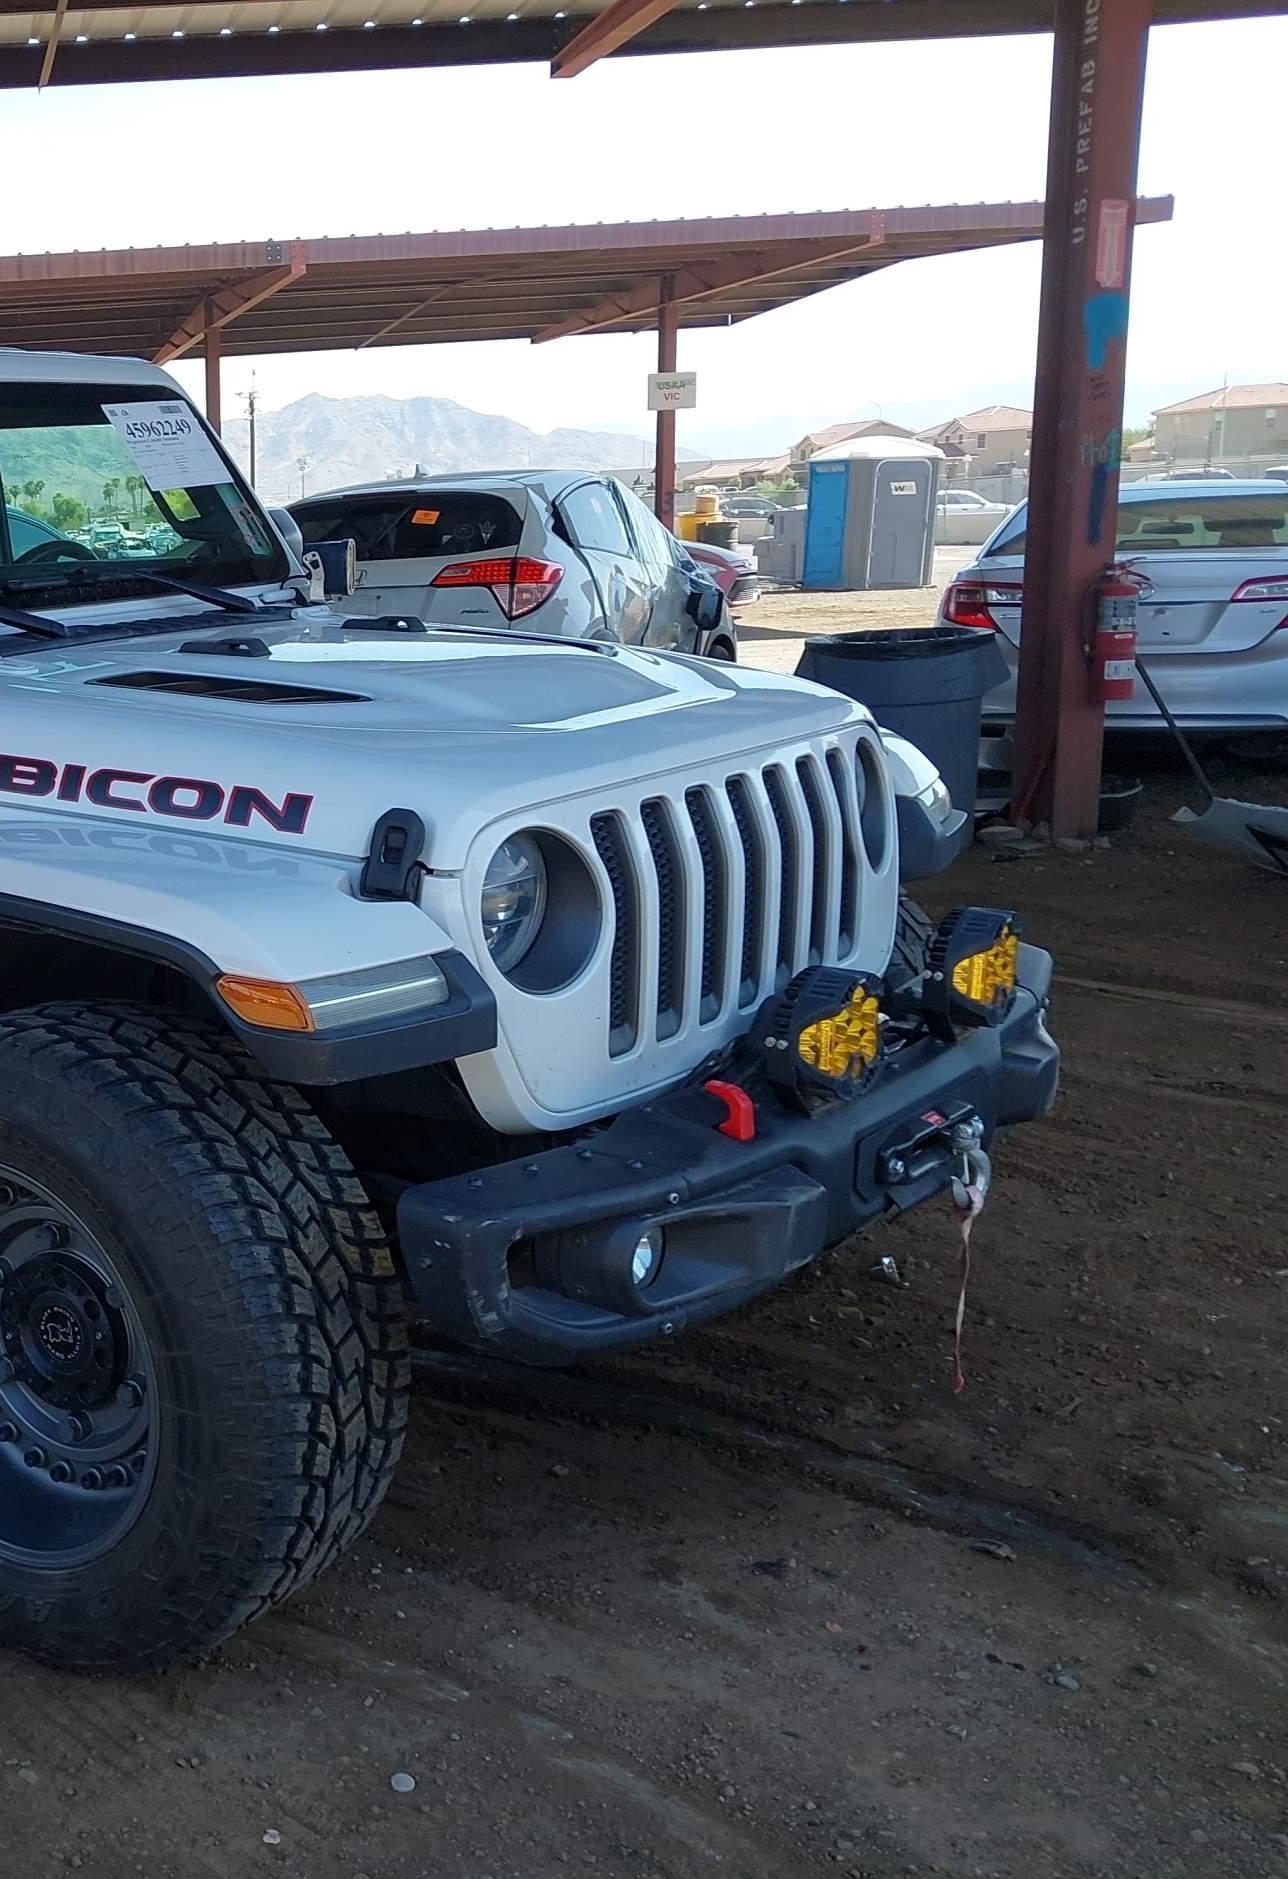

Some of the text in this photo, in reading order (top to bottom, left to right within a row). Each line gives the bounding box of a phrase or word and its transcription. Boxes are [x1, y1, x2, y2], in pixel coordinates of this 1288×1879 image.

[1076, 59, 1096, 174] PREFAB
[1072, 189, 1088, 244] U.S.
[664, 392, 680, 401] VIC
[125, 417, 192, 439] 45962249
